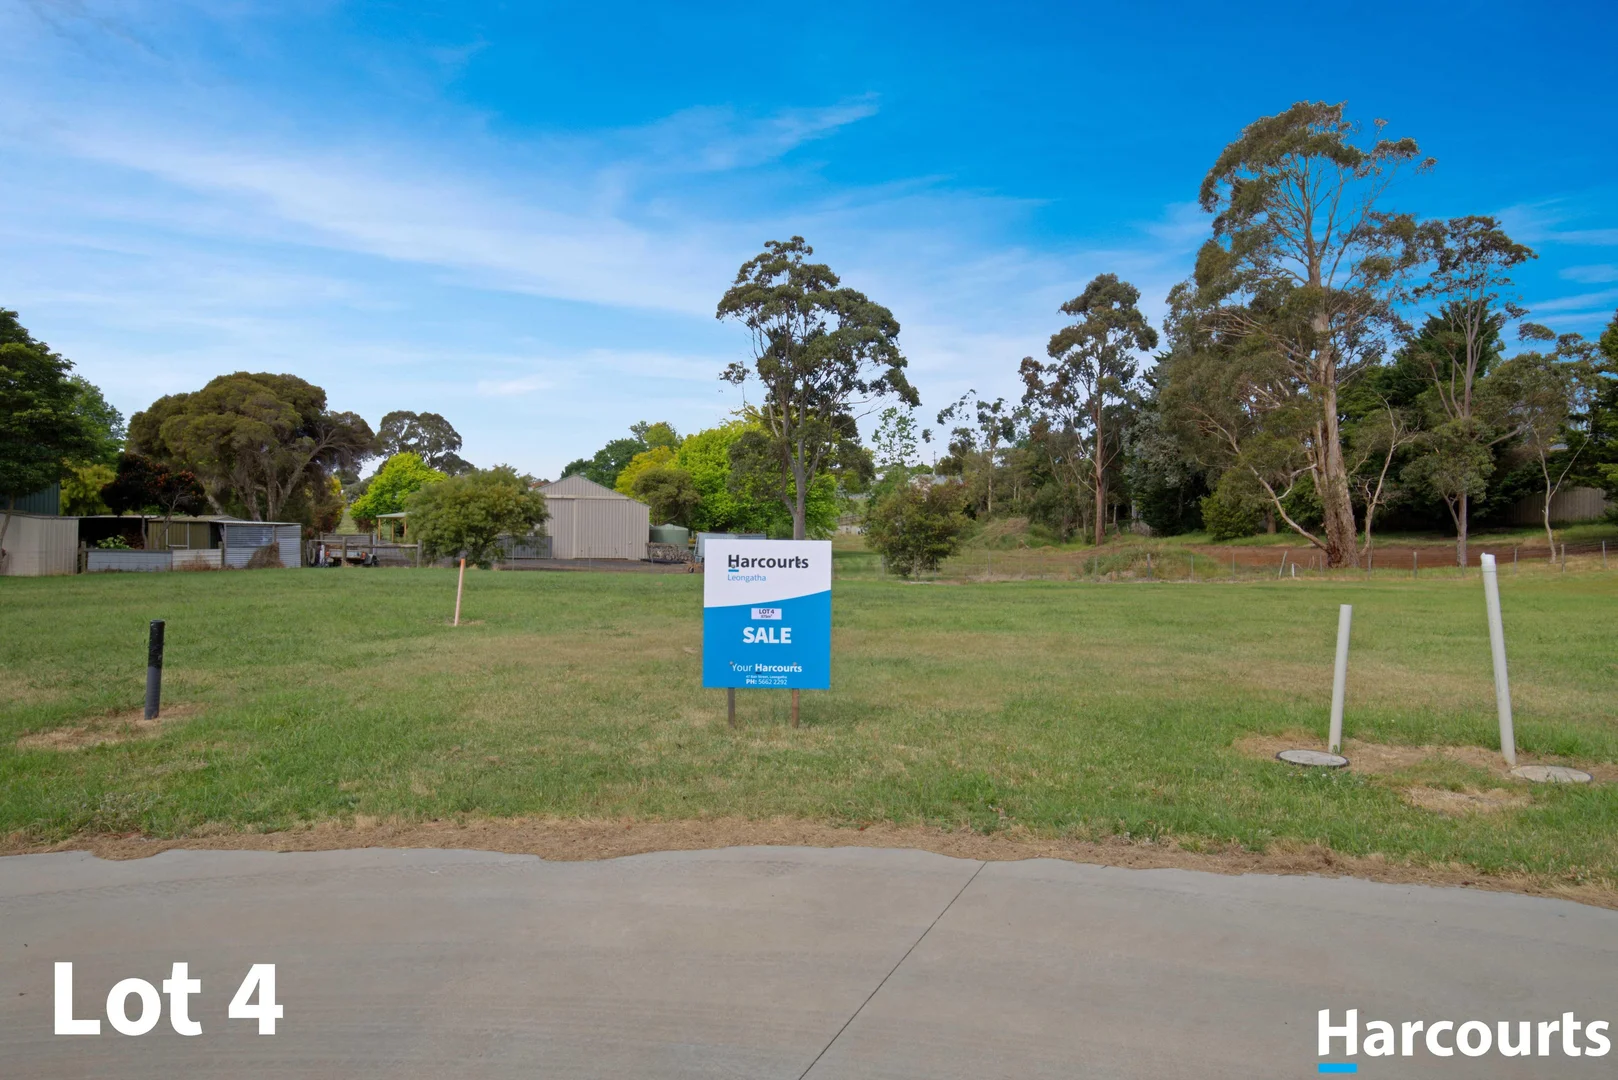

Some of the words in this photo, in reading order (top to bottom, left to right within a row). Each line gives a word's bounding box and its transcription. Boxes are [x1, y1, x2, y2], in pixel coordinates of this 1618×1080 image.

[728, 554, 809, 569] Harcourts
[727, 574, 767, 582] Leongatha
[742, 626, 792, 644] SALE
[732, 663, 753, 672] Your
[755, 663, 803, 673] Harcourts
